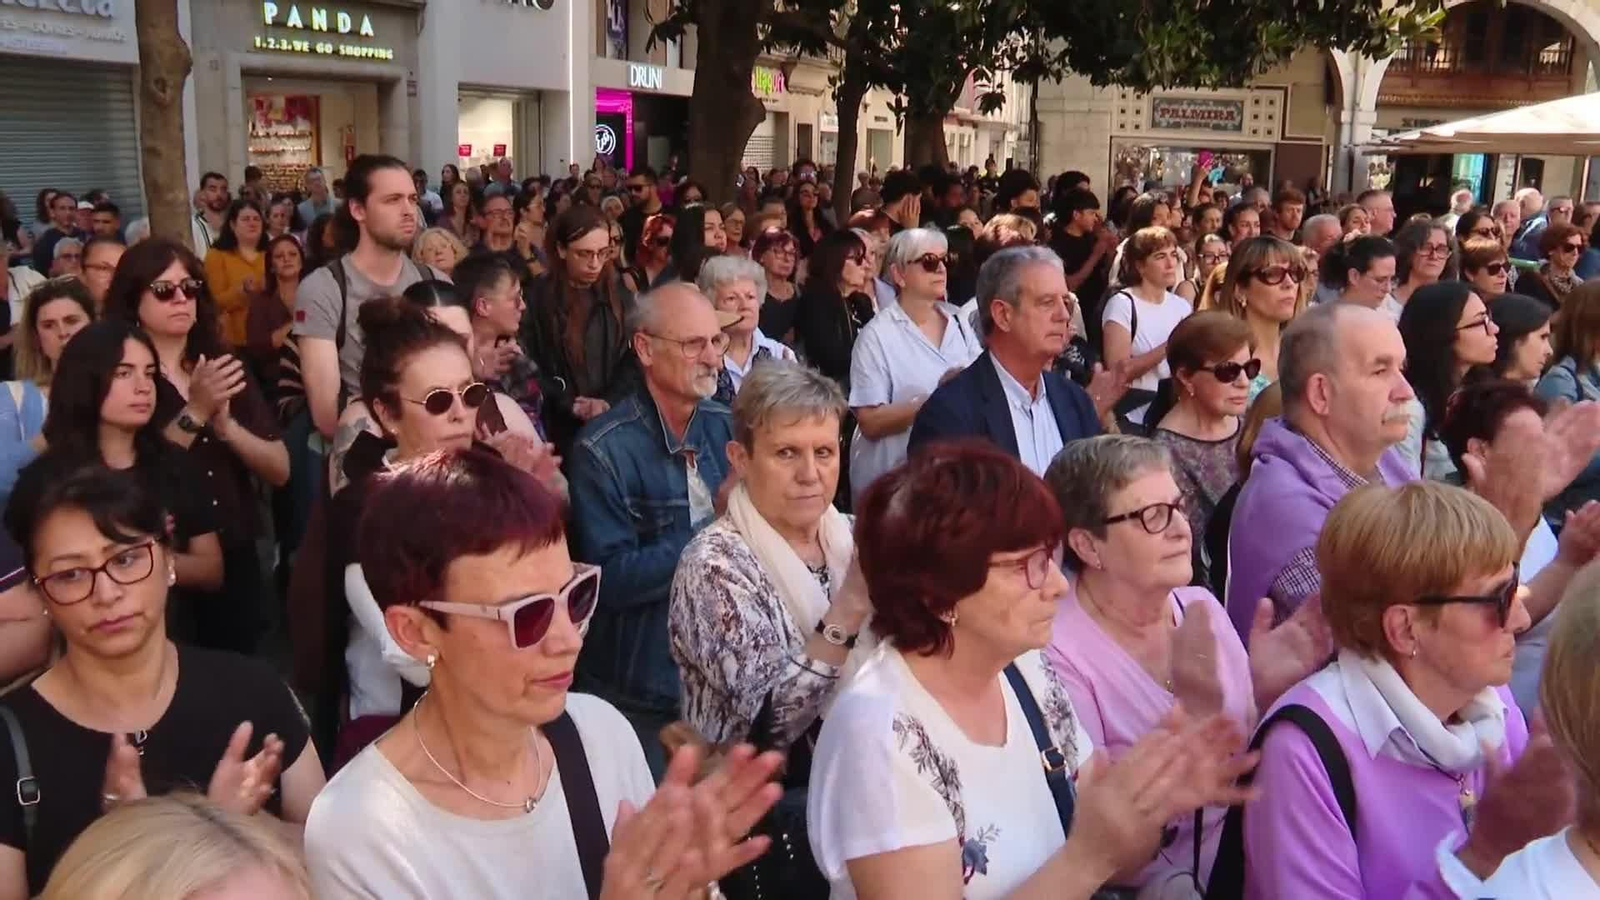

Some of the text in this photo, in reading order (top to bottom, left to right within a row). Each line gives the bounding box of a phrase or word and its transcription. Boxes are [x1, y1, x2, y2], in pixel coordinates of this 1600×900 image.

[263, 1, 374, 37] PANDA
[316, 42, 333, 54] GO
[339, 44, 393, 60] SHOPPING
[630, 64, 662, 89] DRUNI
[1160, 106, 1235, 121] PALMIRA
